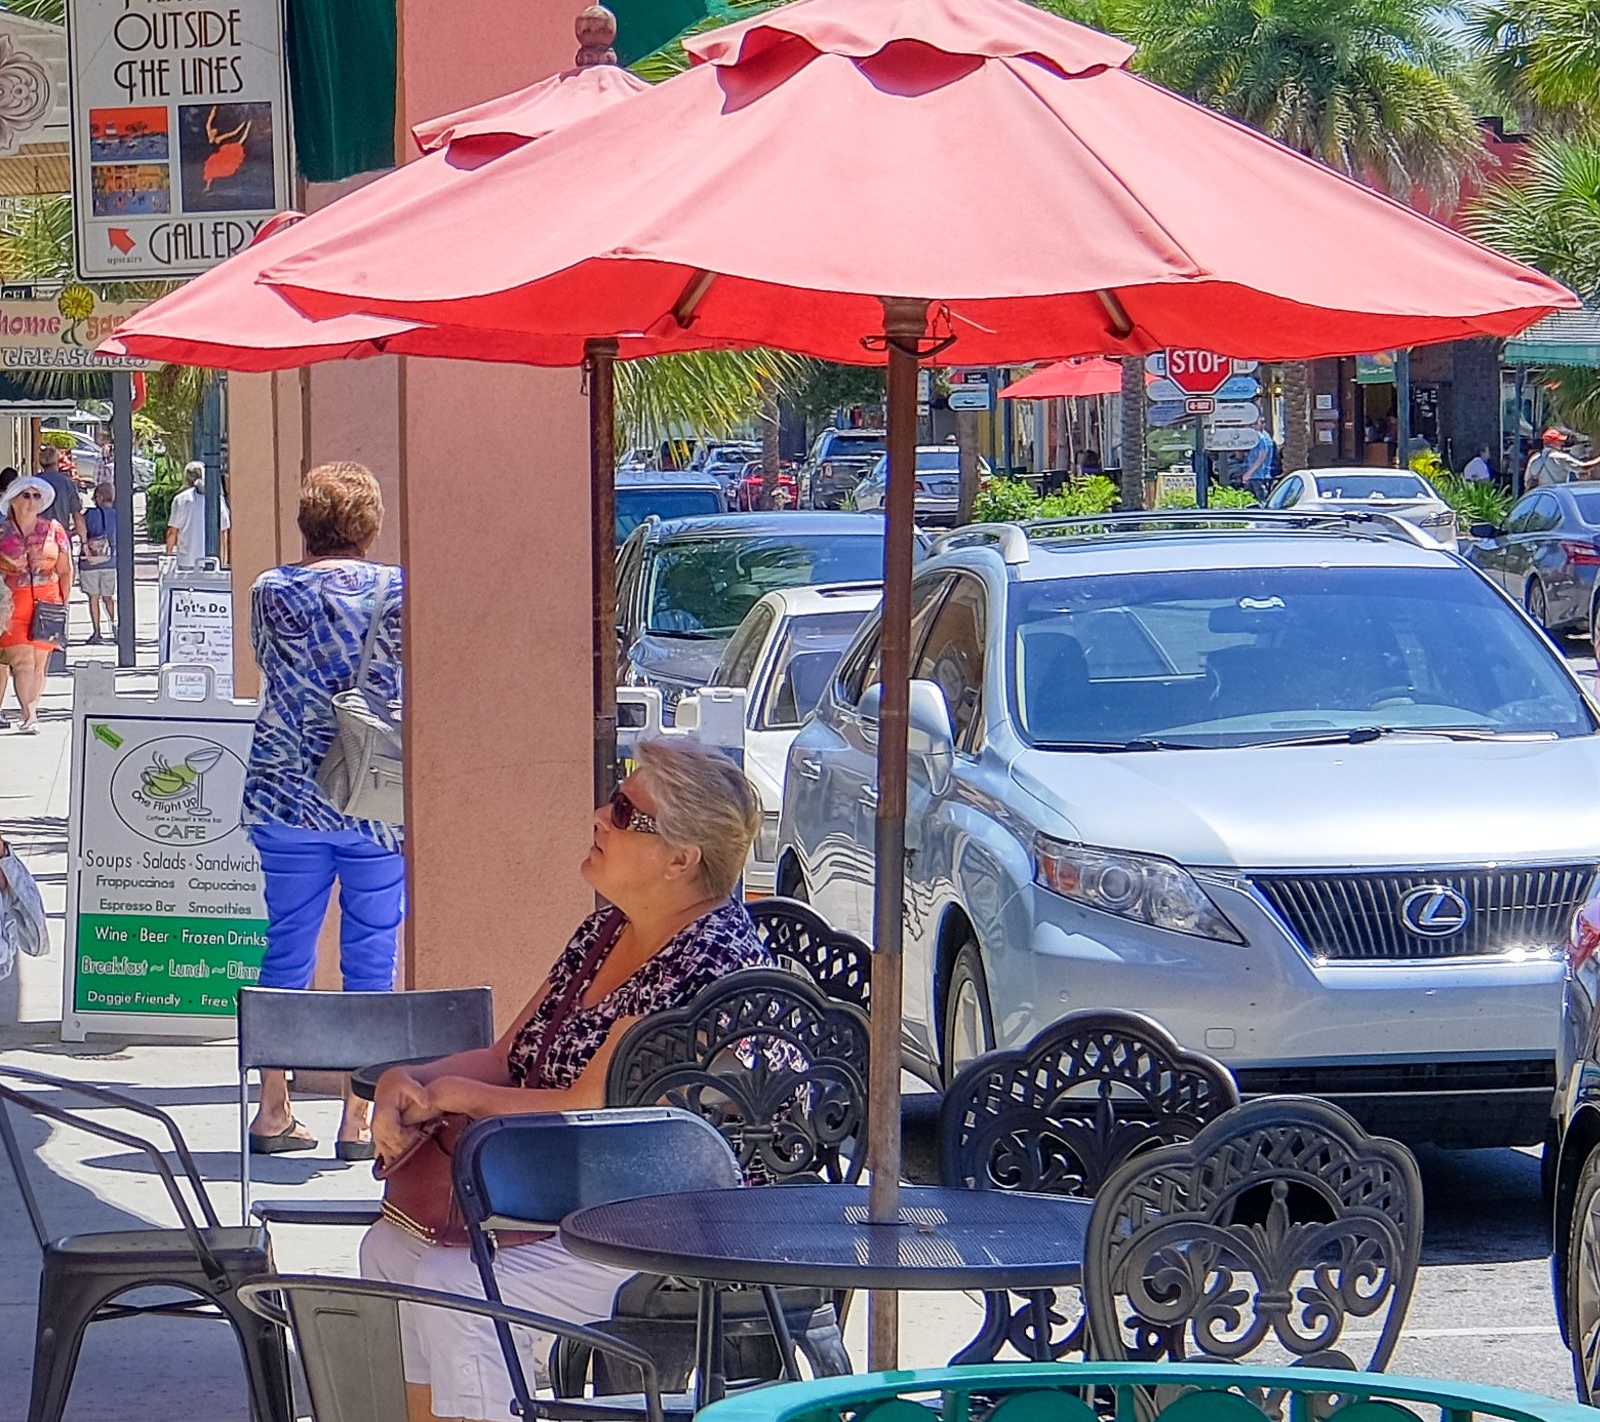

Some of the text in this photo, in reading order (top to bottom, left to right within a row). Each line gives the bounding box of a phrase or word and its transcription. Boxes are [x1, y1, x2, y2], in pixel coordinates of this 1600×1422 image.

[114, 9, 242, 52] OUTSIDE
[114, 55, 244, 103] THE LINES
[107, 254, 144, 265] upstairs
[208, 603, 227, 614] Do
[132, 790, 150, 808] One
[153, 801, 181, 814] Flight
[154, 824, 206, 840] CAFE
[86, 850, 132, 871] Soups
[143, 851, 186, 870] Salads
[96, 875, 257, 892] Frappuccinos Capuccinos
[100, 899, 252, 915] Espresso Bar Smoothies
[95, 926, 268, 947] Wine Beer Frozen Drinks
[82, 955, 261, 980] Breakfast Lunch Dinn
[87, 990, 132, 1006] Doggie
[135, 992, 181, 1007] Friendly
[201, 994, 228, 1008] Free
